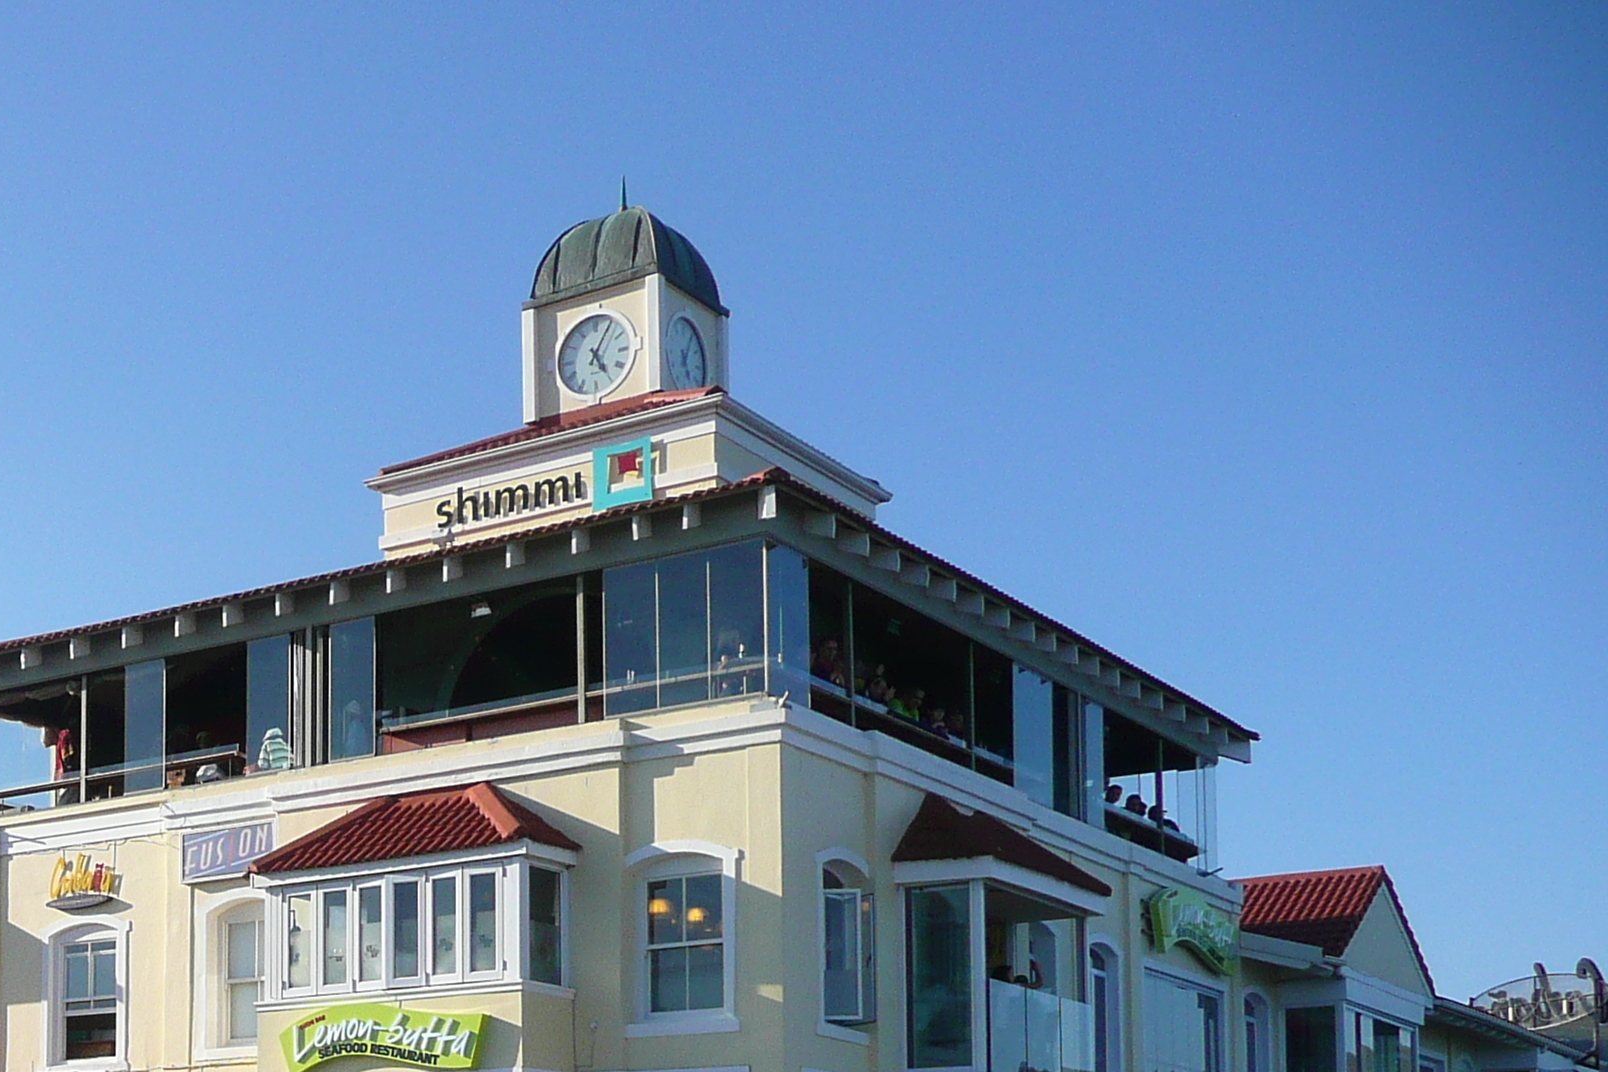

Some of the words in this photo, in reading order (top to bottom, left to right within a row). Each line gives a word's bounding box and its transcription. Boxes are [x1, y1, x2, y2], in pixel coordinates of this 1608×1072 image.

[185, 824, 270, 875] FUSION
[318, 1042, 368, 1060] SEAFOOD
[370, 1043, 440, 1066] RESTAURANT
